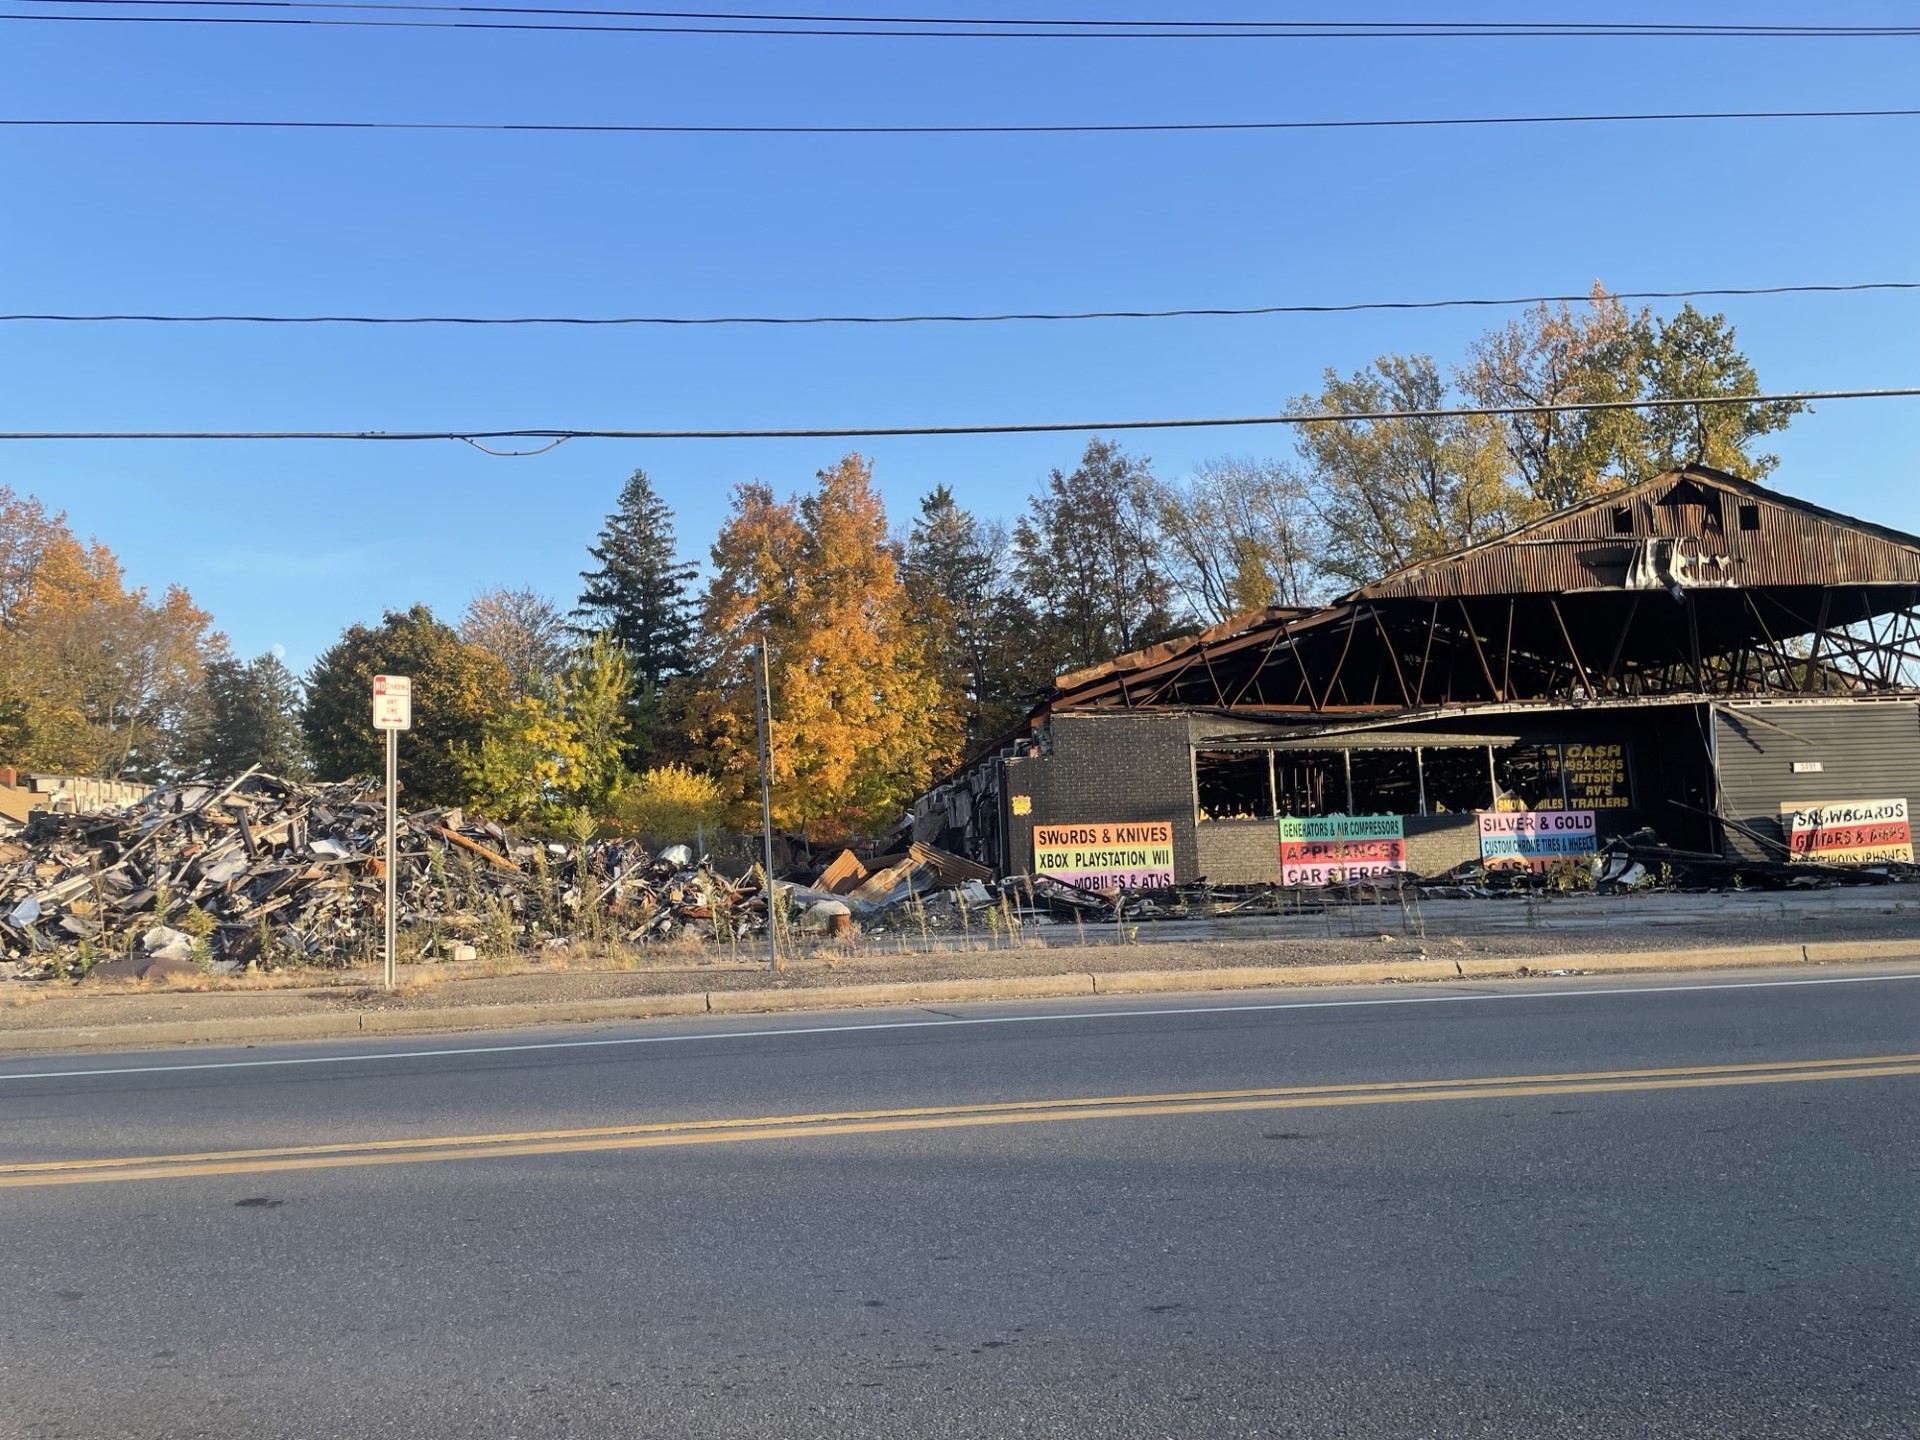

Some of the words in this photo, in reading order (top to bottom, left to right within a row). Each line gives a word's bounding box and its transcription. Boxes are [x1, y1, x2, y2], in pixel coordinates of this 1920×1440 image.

[375, 681, 386, 692] NO
[1570, 797, 1629, 809] TRAILERS
[1284, 823, 1328, 838] GENERATORS
[1330, 823, 1335, 835] &
[1337, 822, 1349, 836] AIR
[1350, 820, 1399, 836] COMPRESSORS
[1483, 816, 1535, 832] SILVER
[1540, 817, 1549, 830] &
[1554, 815, 1592, 829] GOLD
[1038, 829, 1097, 846] SWORDS
[1102, 828, 1111, 843] &
[1116, 826, 1167, 843] KNIVES
[1484, 840, 1512, 854] CUSTOM
[1542, 838, 1561, 852] TIRES
[1562, 839, 1567, 851] &
[1568, 836, 1594, 851] WHEELS
[1039, 853, 1068, 869] XBOX
[1075, 851, 1146, 867] PLAYSTATION
[1152, 850, 1169, 865] WII
[1130, 874, 1138, 889] &
[1288, 868, 1322, 884] CAR
